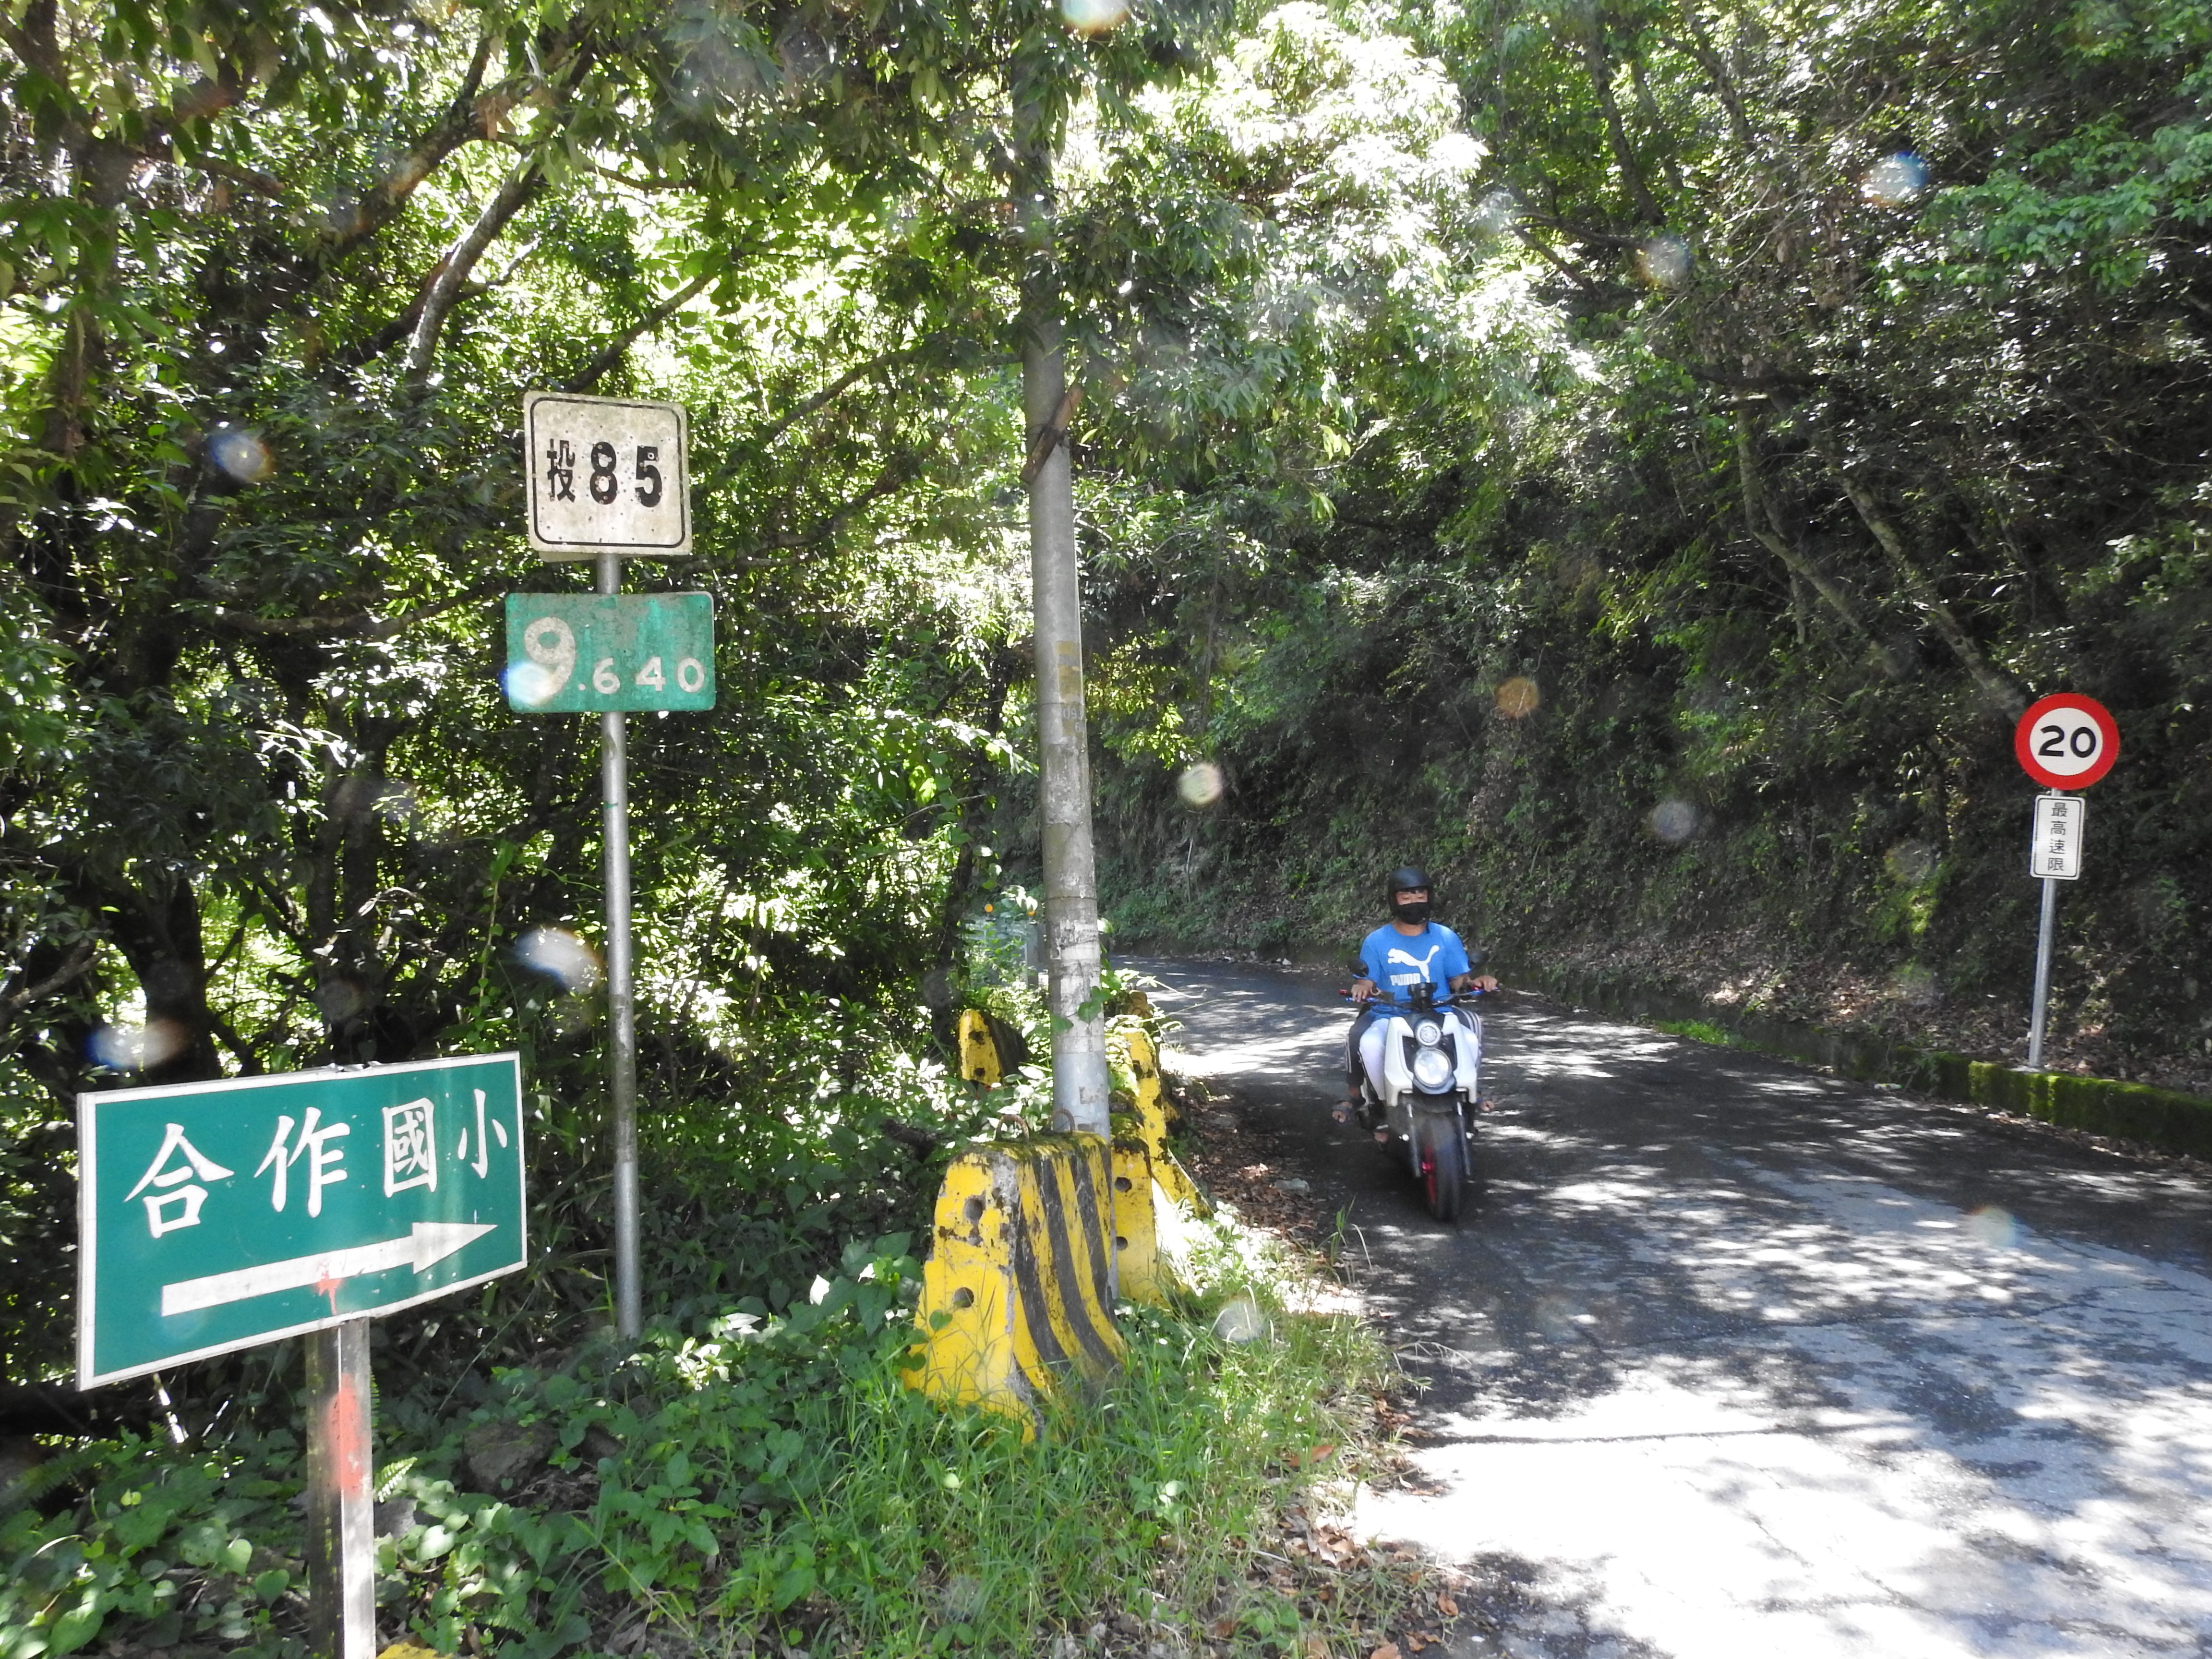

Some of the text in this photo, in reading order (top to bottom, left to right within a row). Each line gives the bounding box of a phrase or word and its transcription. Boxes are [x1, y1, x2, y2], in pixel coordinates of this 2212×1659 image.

[547, 438, 662, 508] 投85
[524, 616, 705, 706] 9.640
[2038, 725, 2096, 758] 20
[2047, 802, 2068, 871] 最高速限
[1390, 973, 1421, 986] PUMA
[123, 1088, 508, 1239] 合作國小
